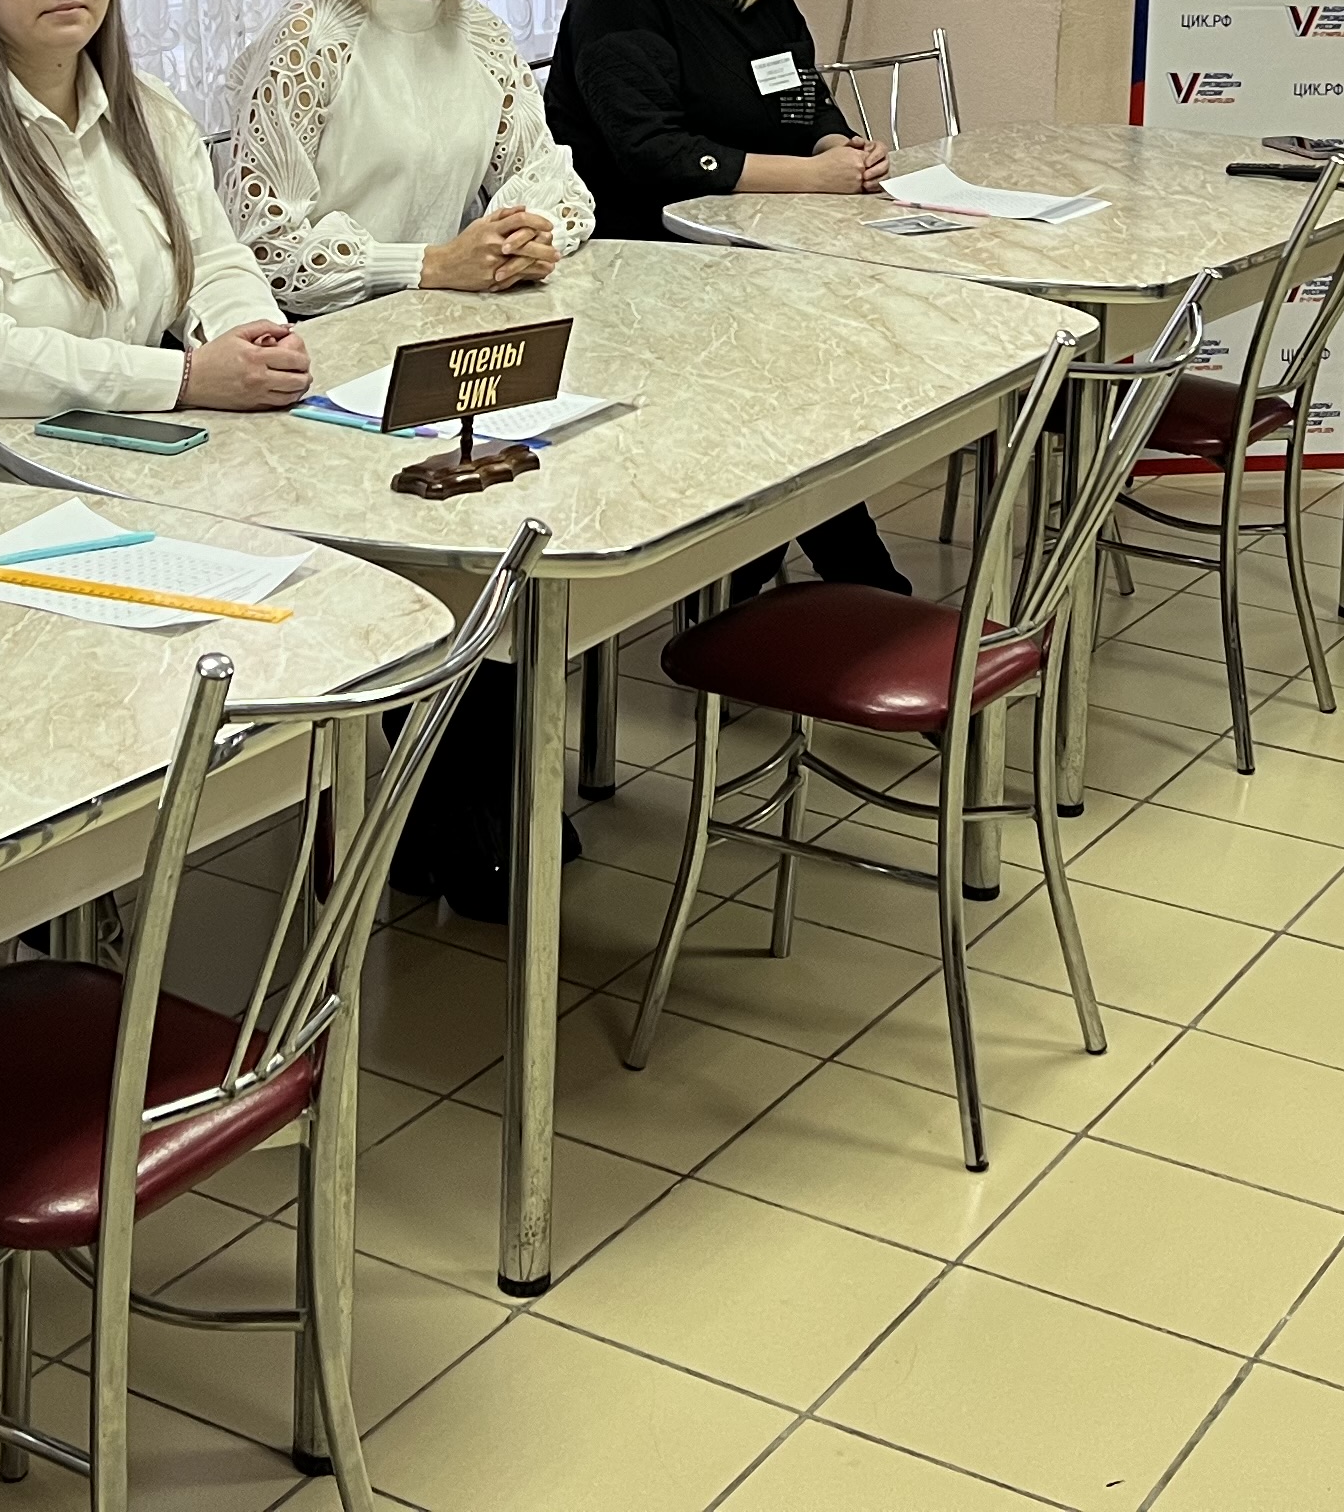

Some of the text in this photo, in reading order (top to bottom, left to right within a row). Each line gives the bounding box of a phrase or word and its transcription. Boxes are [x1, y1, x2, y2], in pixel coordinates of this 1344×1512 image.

[1181, 14, 1232, 29] ЦИК.РФ
[1293, 83, 1344, 97] ЦИК.РФ
[456, 374, 501, 411] УИК
